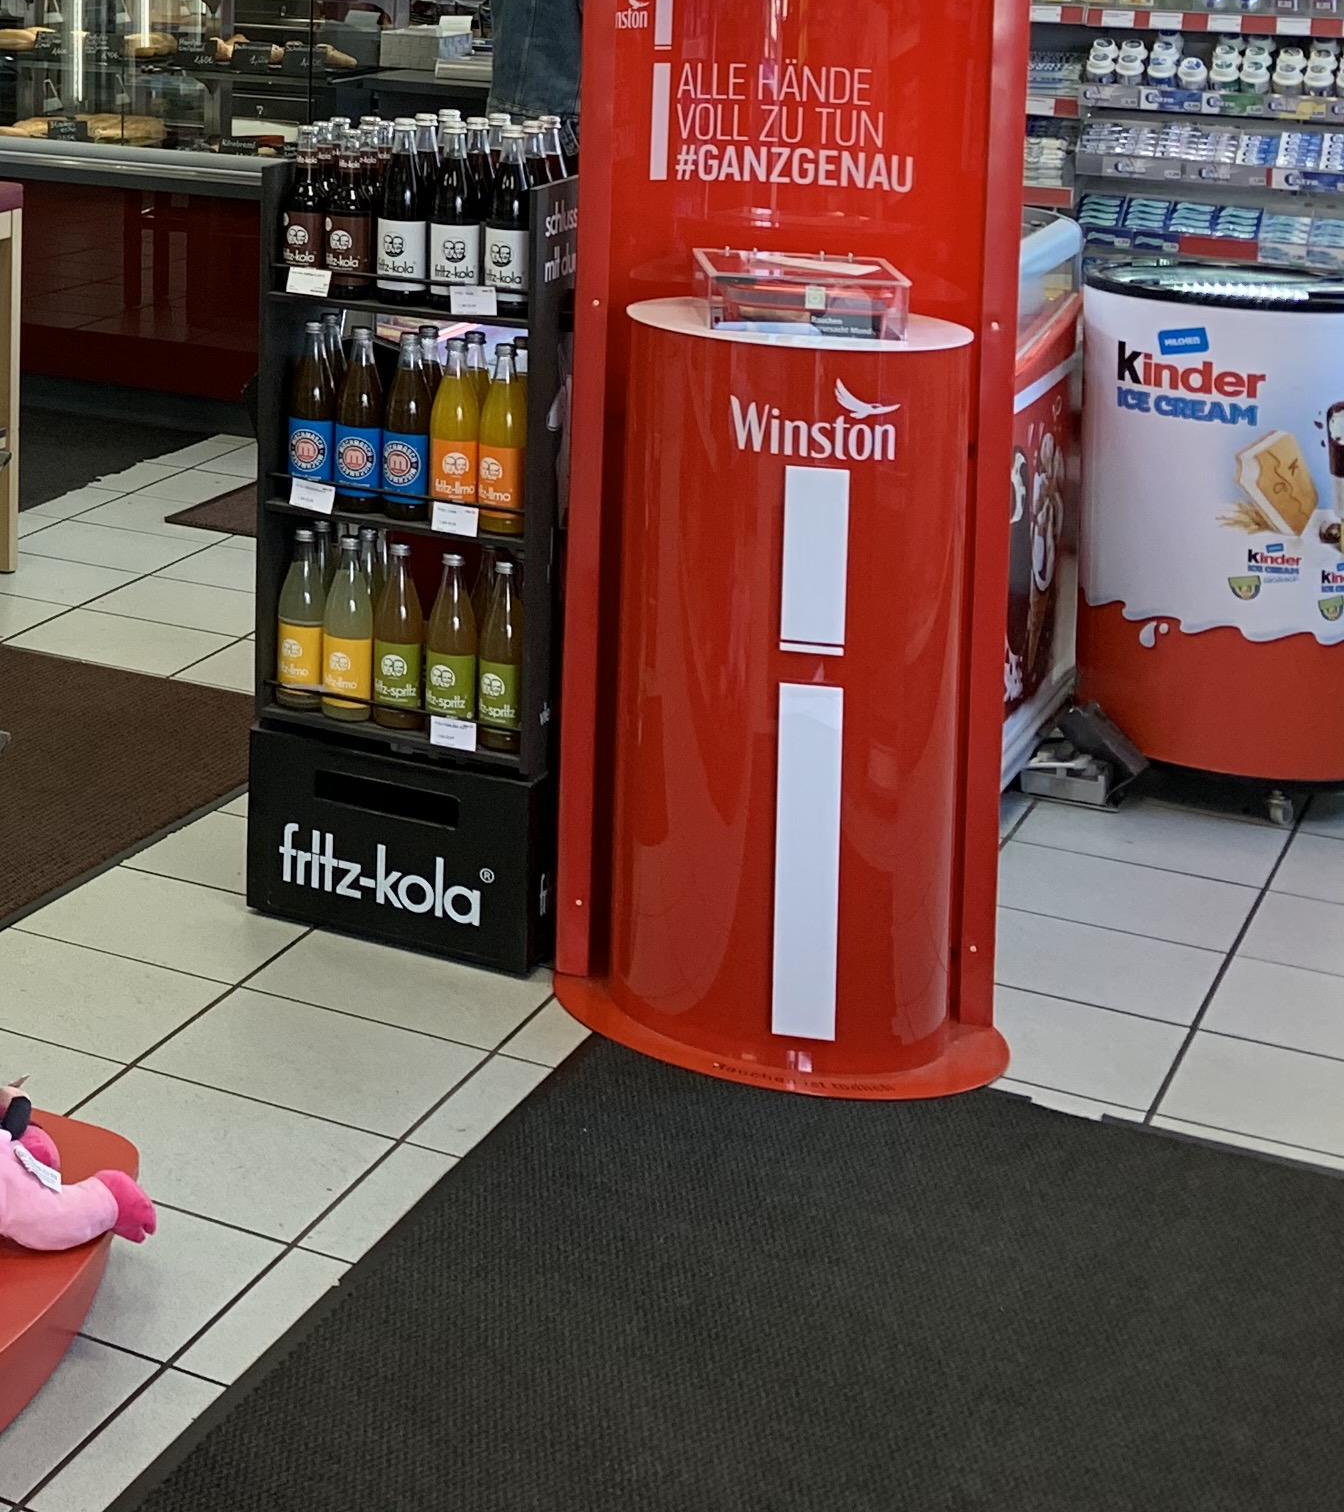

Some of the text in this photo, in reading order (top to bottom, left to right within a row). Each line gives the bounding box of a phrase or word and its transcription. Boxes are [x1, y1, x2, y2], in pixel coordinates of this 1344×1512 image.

[676, 59, 873, 106] ALLE HÄNDE
[676, 104, 885, 148] VOLL ZU TUN
[675, 144, 913, 193] #GANZGENAU
[434, 264, 474, 280] fritz-kola
[1117, 340, 1266, 399] kinder
[730, 394, 896, 461] Winston
[1117, 387, 1258, 426] ICE CREAM
[1248, 565, 1299, 575] ICE CREAM
[279, 822, 481, 926] fritz-kola
